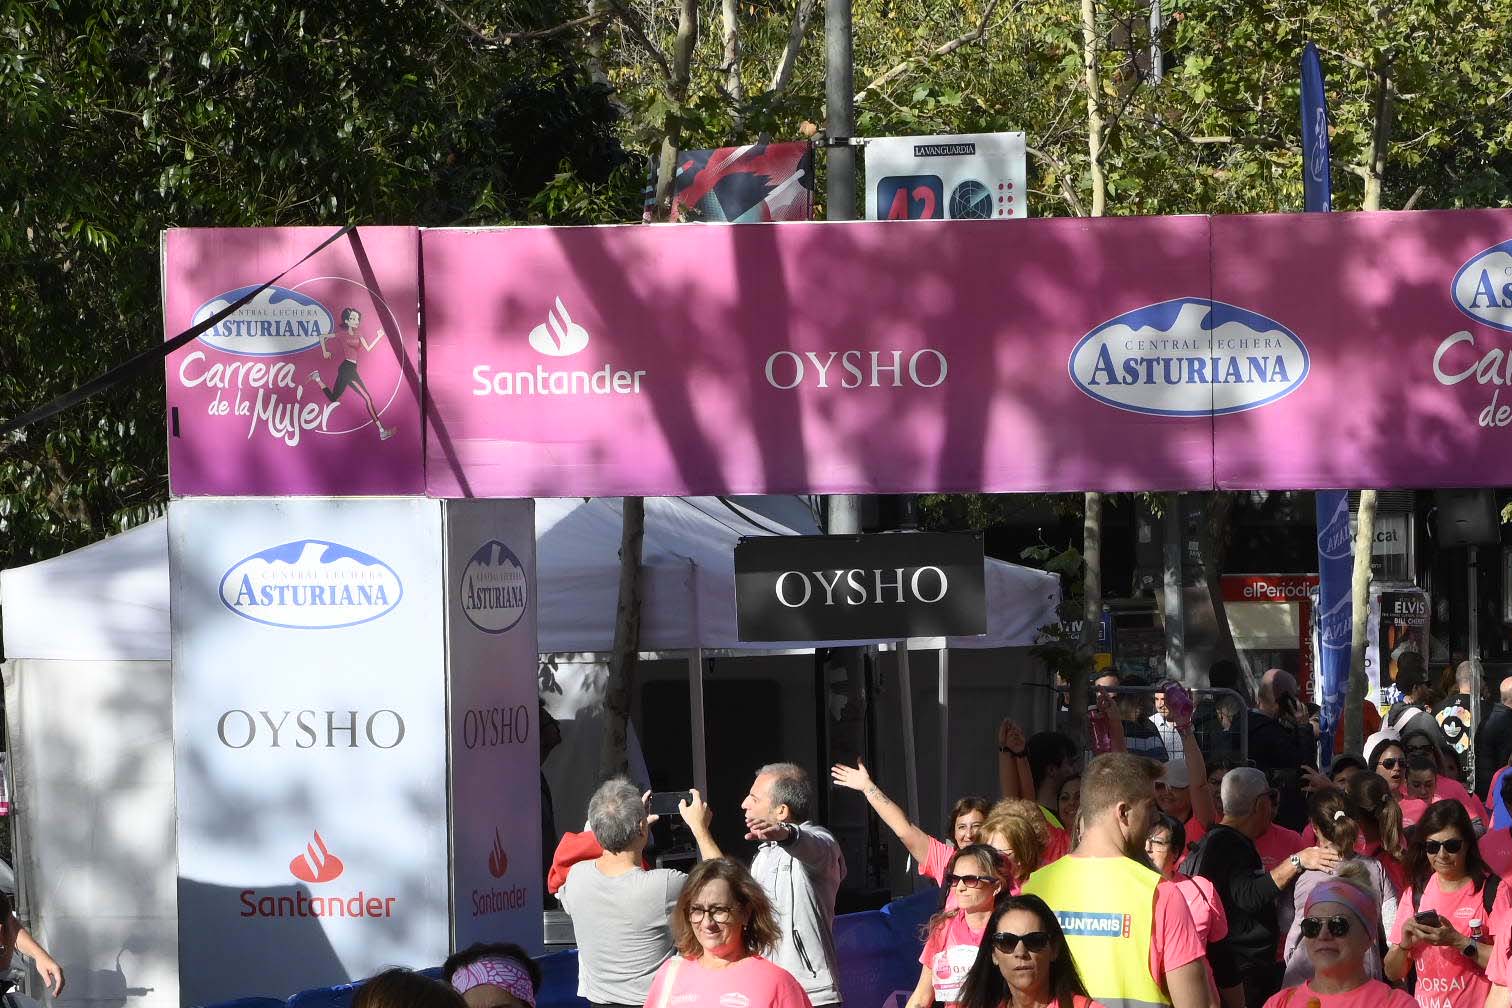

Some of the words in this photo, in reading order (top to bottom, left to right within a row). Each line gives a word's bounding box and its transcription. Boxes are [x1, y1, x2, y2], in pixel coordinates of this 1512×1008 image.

[1125, 339, 1200, 351] CENTRAL
[1207, 337, 1283, 350] LECHERA
[179, 350, 297, 389] Carrera
[472, 363, 647, 396] Santander
[765, 348, 949, 390] OYSHO
[1087, 342, 1291, 386] ASTURIANA
[207, 391, 229, 416] de
[235, 388, 250, 416] la
[248, 385, 340, 447] Mujer
[1478, 389, 1512, 427] de
[233, 574, 390, 607] ASTURIANA
[465, 575, 525, 611] ASTURIANA
[775, 566, 949, 608] OYSHO
[1394, 601, 1425, 614] ELVIS
[217, 708, 406, 749] OYSHO
[464, 704, 529, 751] OYSHO
[240, 889, 396, 918] Santander
[472, 884, 528, 917] Santander
